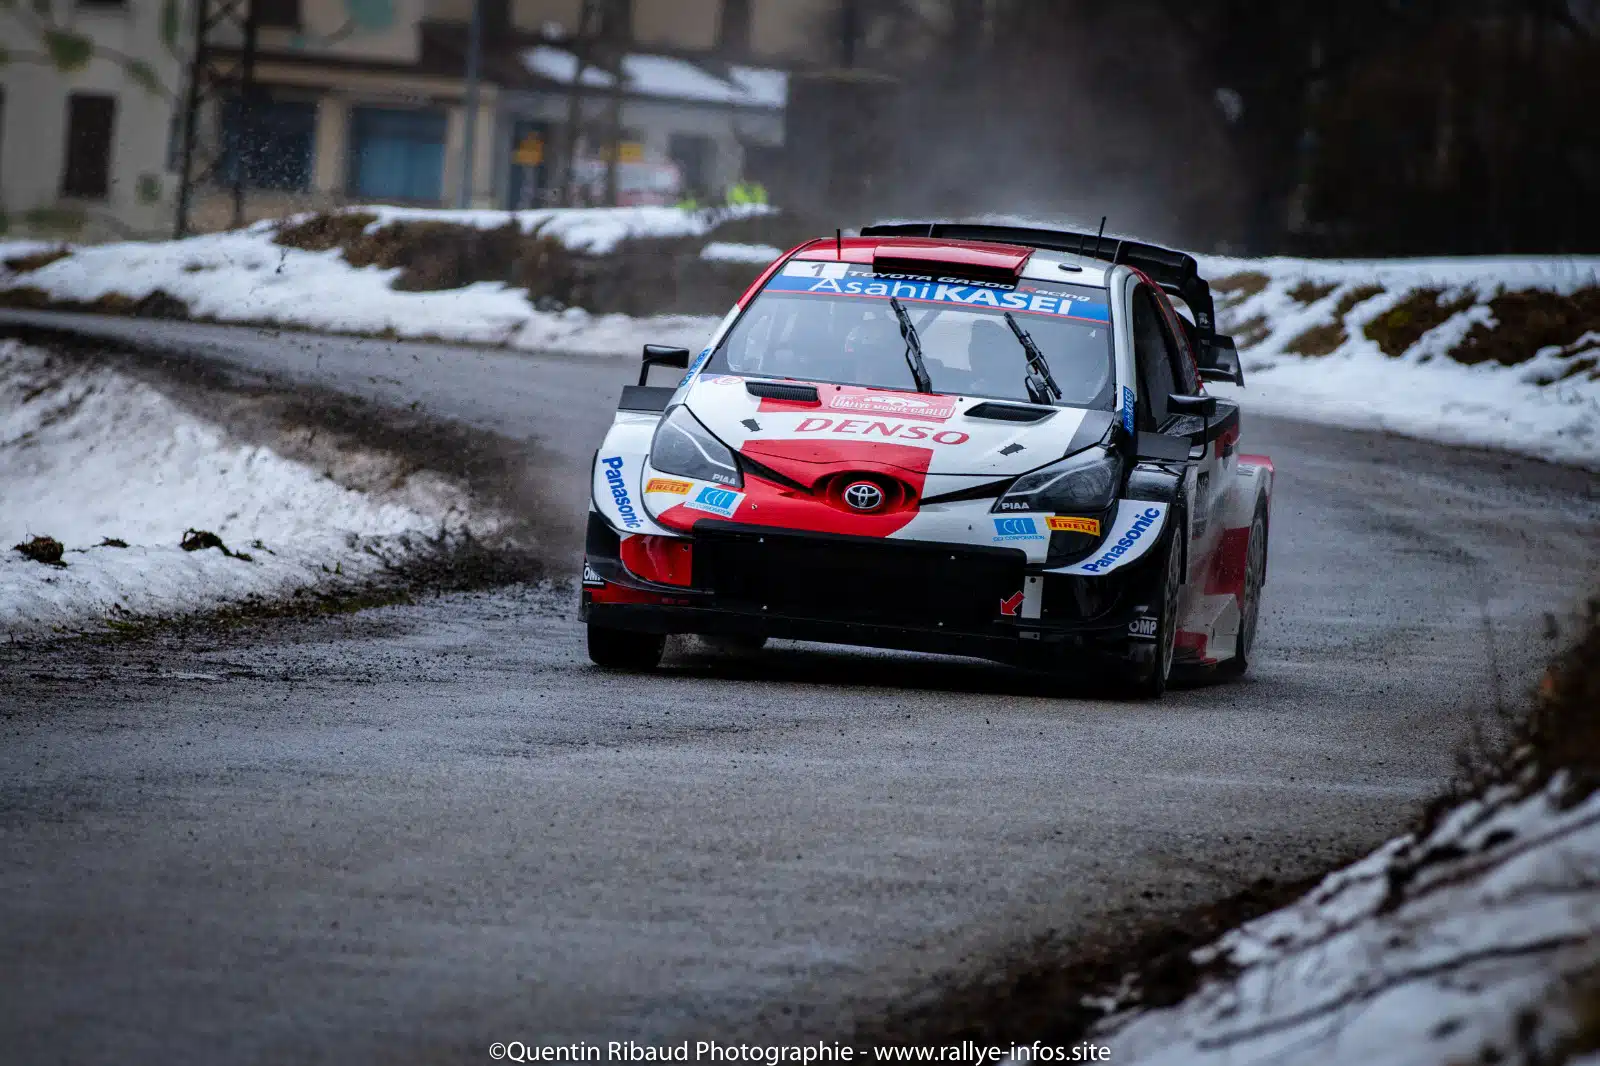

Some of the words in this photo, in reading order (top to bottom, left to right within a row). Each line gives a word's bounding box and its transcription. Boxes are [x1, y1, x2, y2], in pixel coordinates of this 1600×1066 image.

[810, 263, 827, 277] 1
[849, 270, 932, 281] TOYOTA
[937, 276, 1015, 290] GAZOO
[1020, 286, 1090, 302] Racing
[795, 417, 970, 446] DENSO
[648, 479, 689, 493] PIRELLI
[712, 473, 736, 485] PIAA
[602, 456, 643, 529] Panasonic
[1001, 502, 1030, 510] PIAA
[1049, 518, 1097, 533] PIRELLI
[1081, 507, 1161, 573] Panasonic
[1128, 619, 1157, 635] OMP
